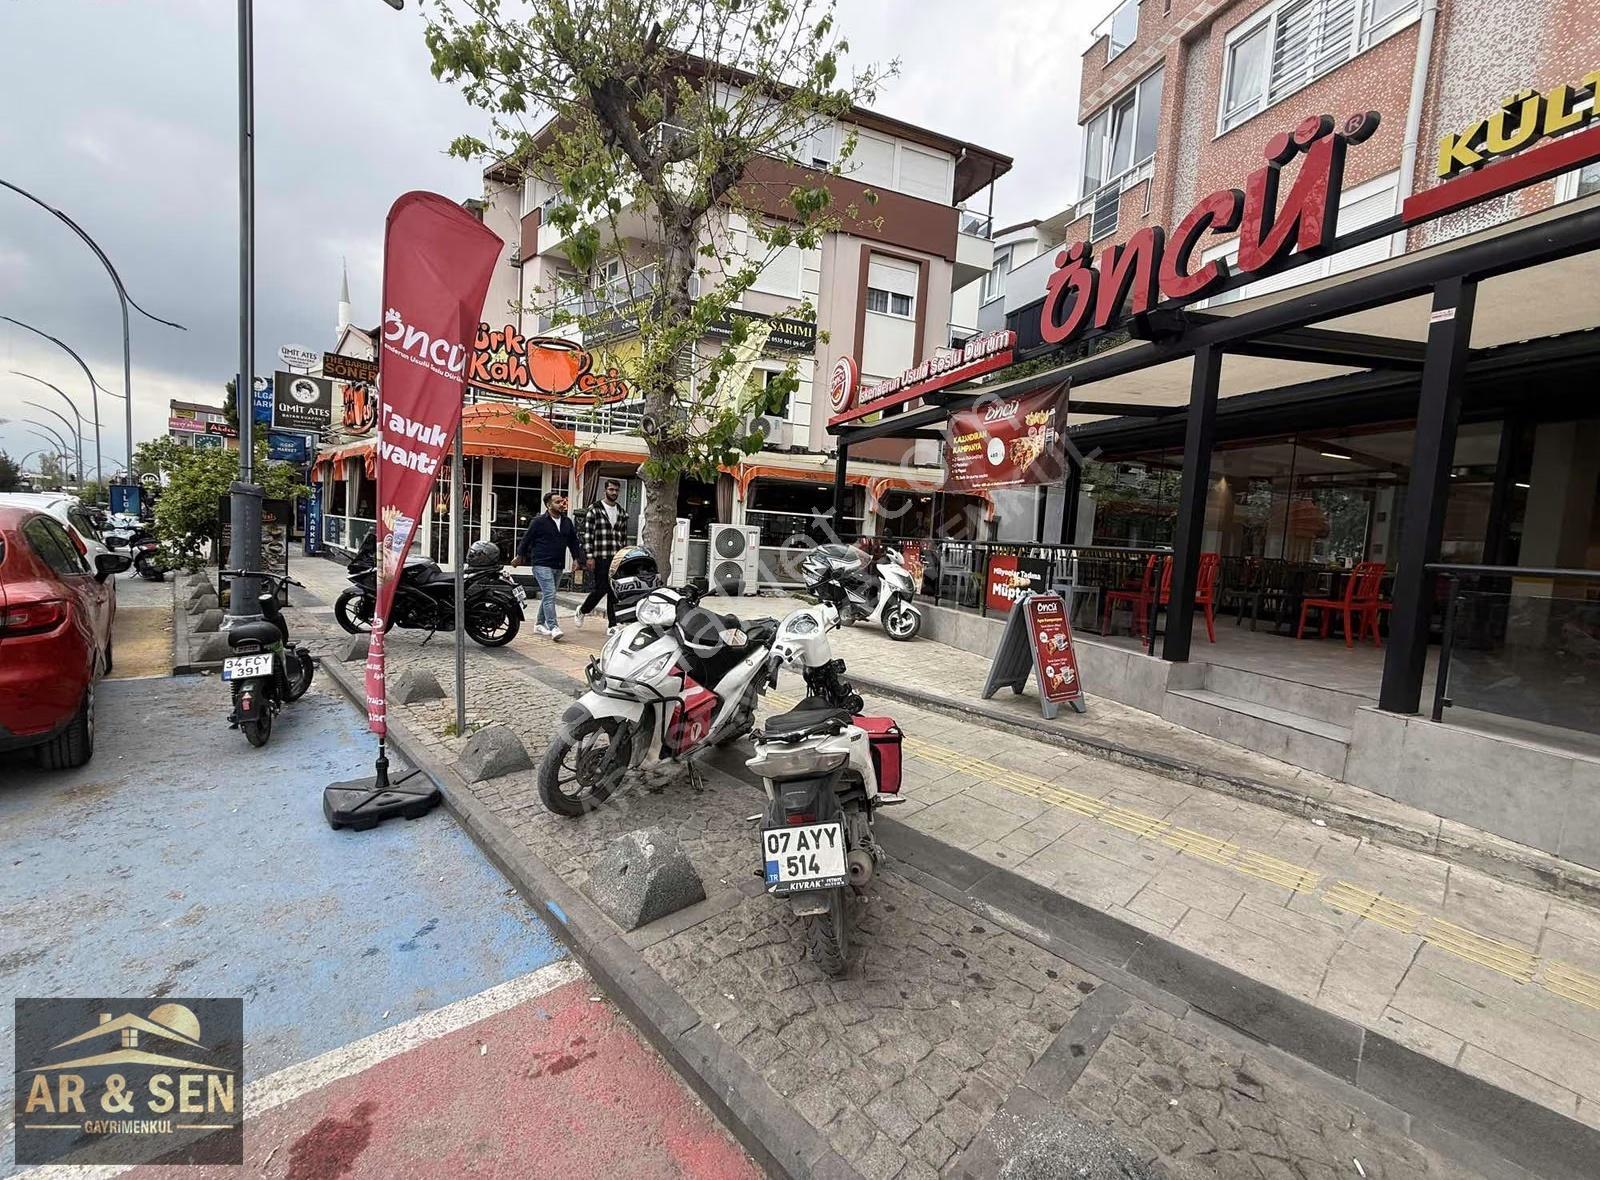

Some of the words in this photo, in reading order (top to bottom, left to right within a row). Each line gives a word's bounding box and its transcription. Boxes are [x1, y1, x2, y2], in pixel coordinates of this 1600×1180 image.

[325, 362, 377, 381] SONER
[226, 659, 243, 669] 34
[237, 666, 260, 677] 391
[767, 832, 791, 854] 07
[796, 826, 837, 852] AYY
[786, 853, 820, 877] 514
[790, 879, 821, 891] KIVRAK
